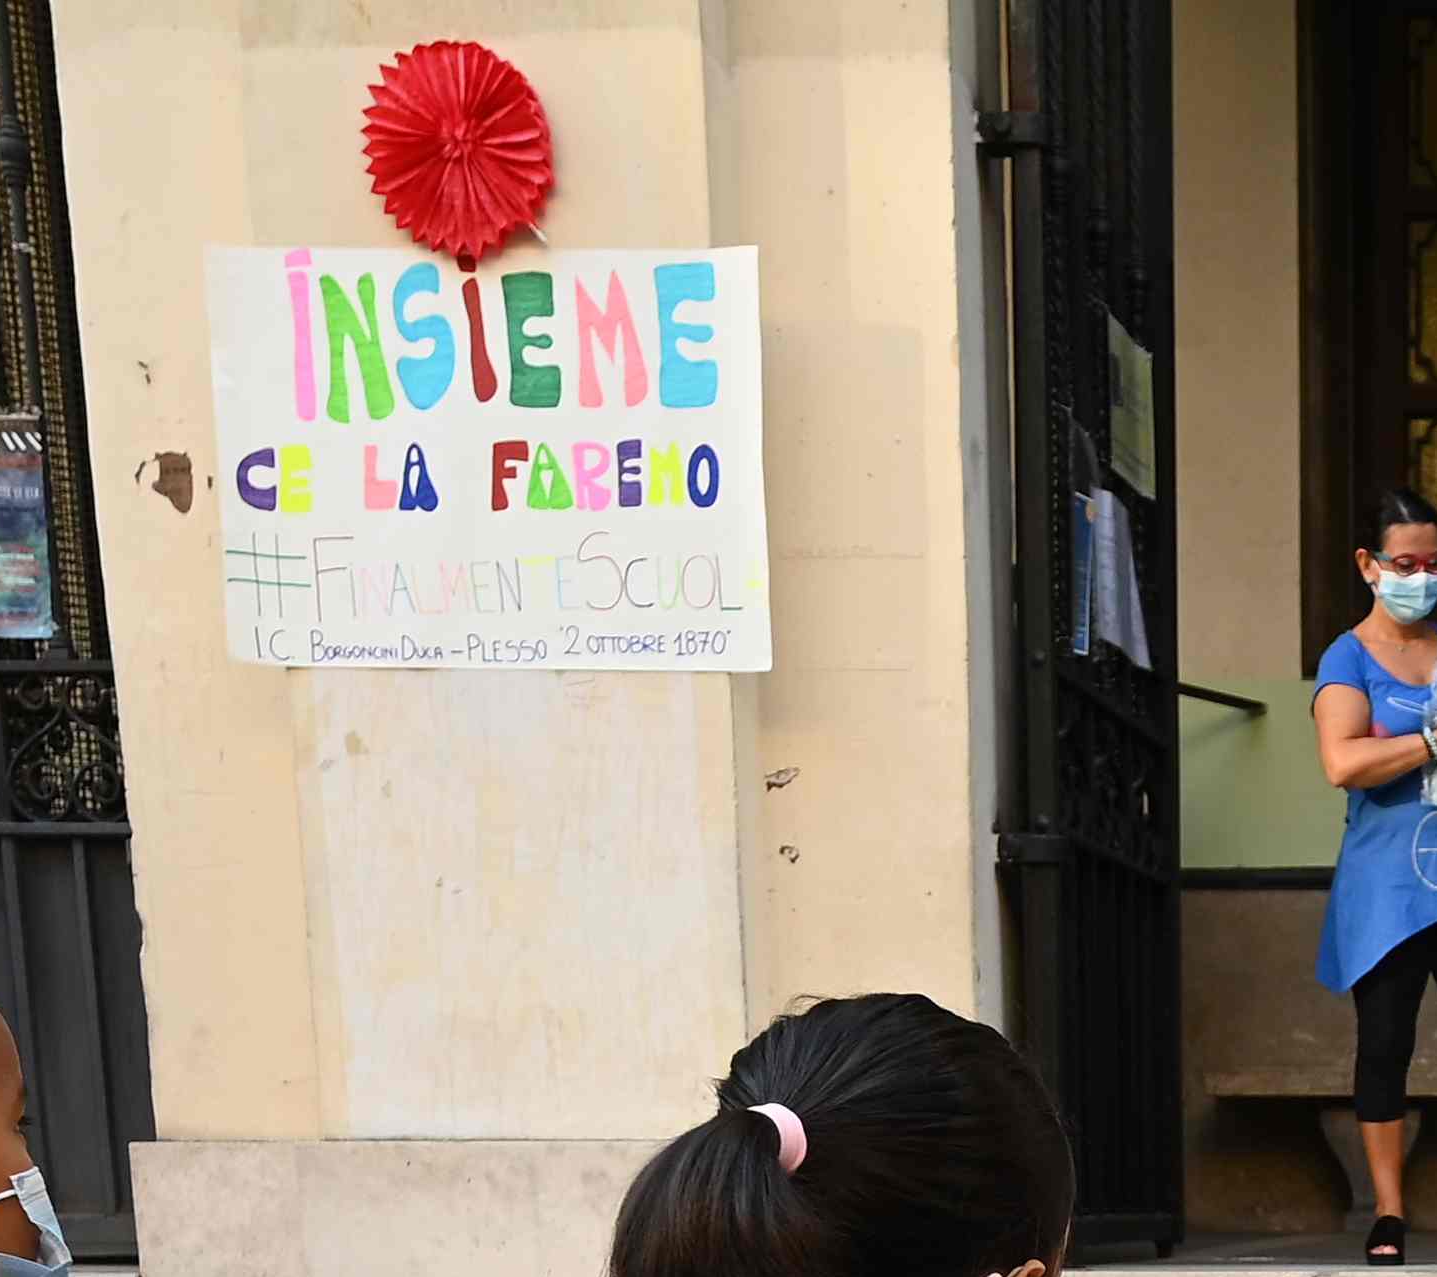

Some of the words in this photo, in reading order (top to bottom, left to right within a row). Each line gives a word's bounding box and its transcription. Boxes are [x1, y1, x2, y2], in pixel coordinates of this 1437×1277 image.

[284, 249, 719, 424] INSIEME
[236, 444, 313, 513] CE
[363, 442, 439, 513] LA
[491, 438, 720, 513] FAREMO
[586, 633, 666, 654] OTTOBRE
